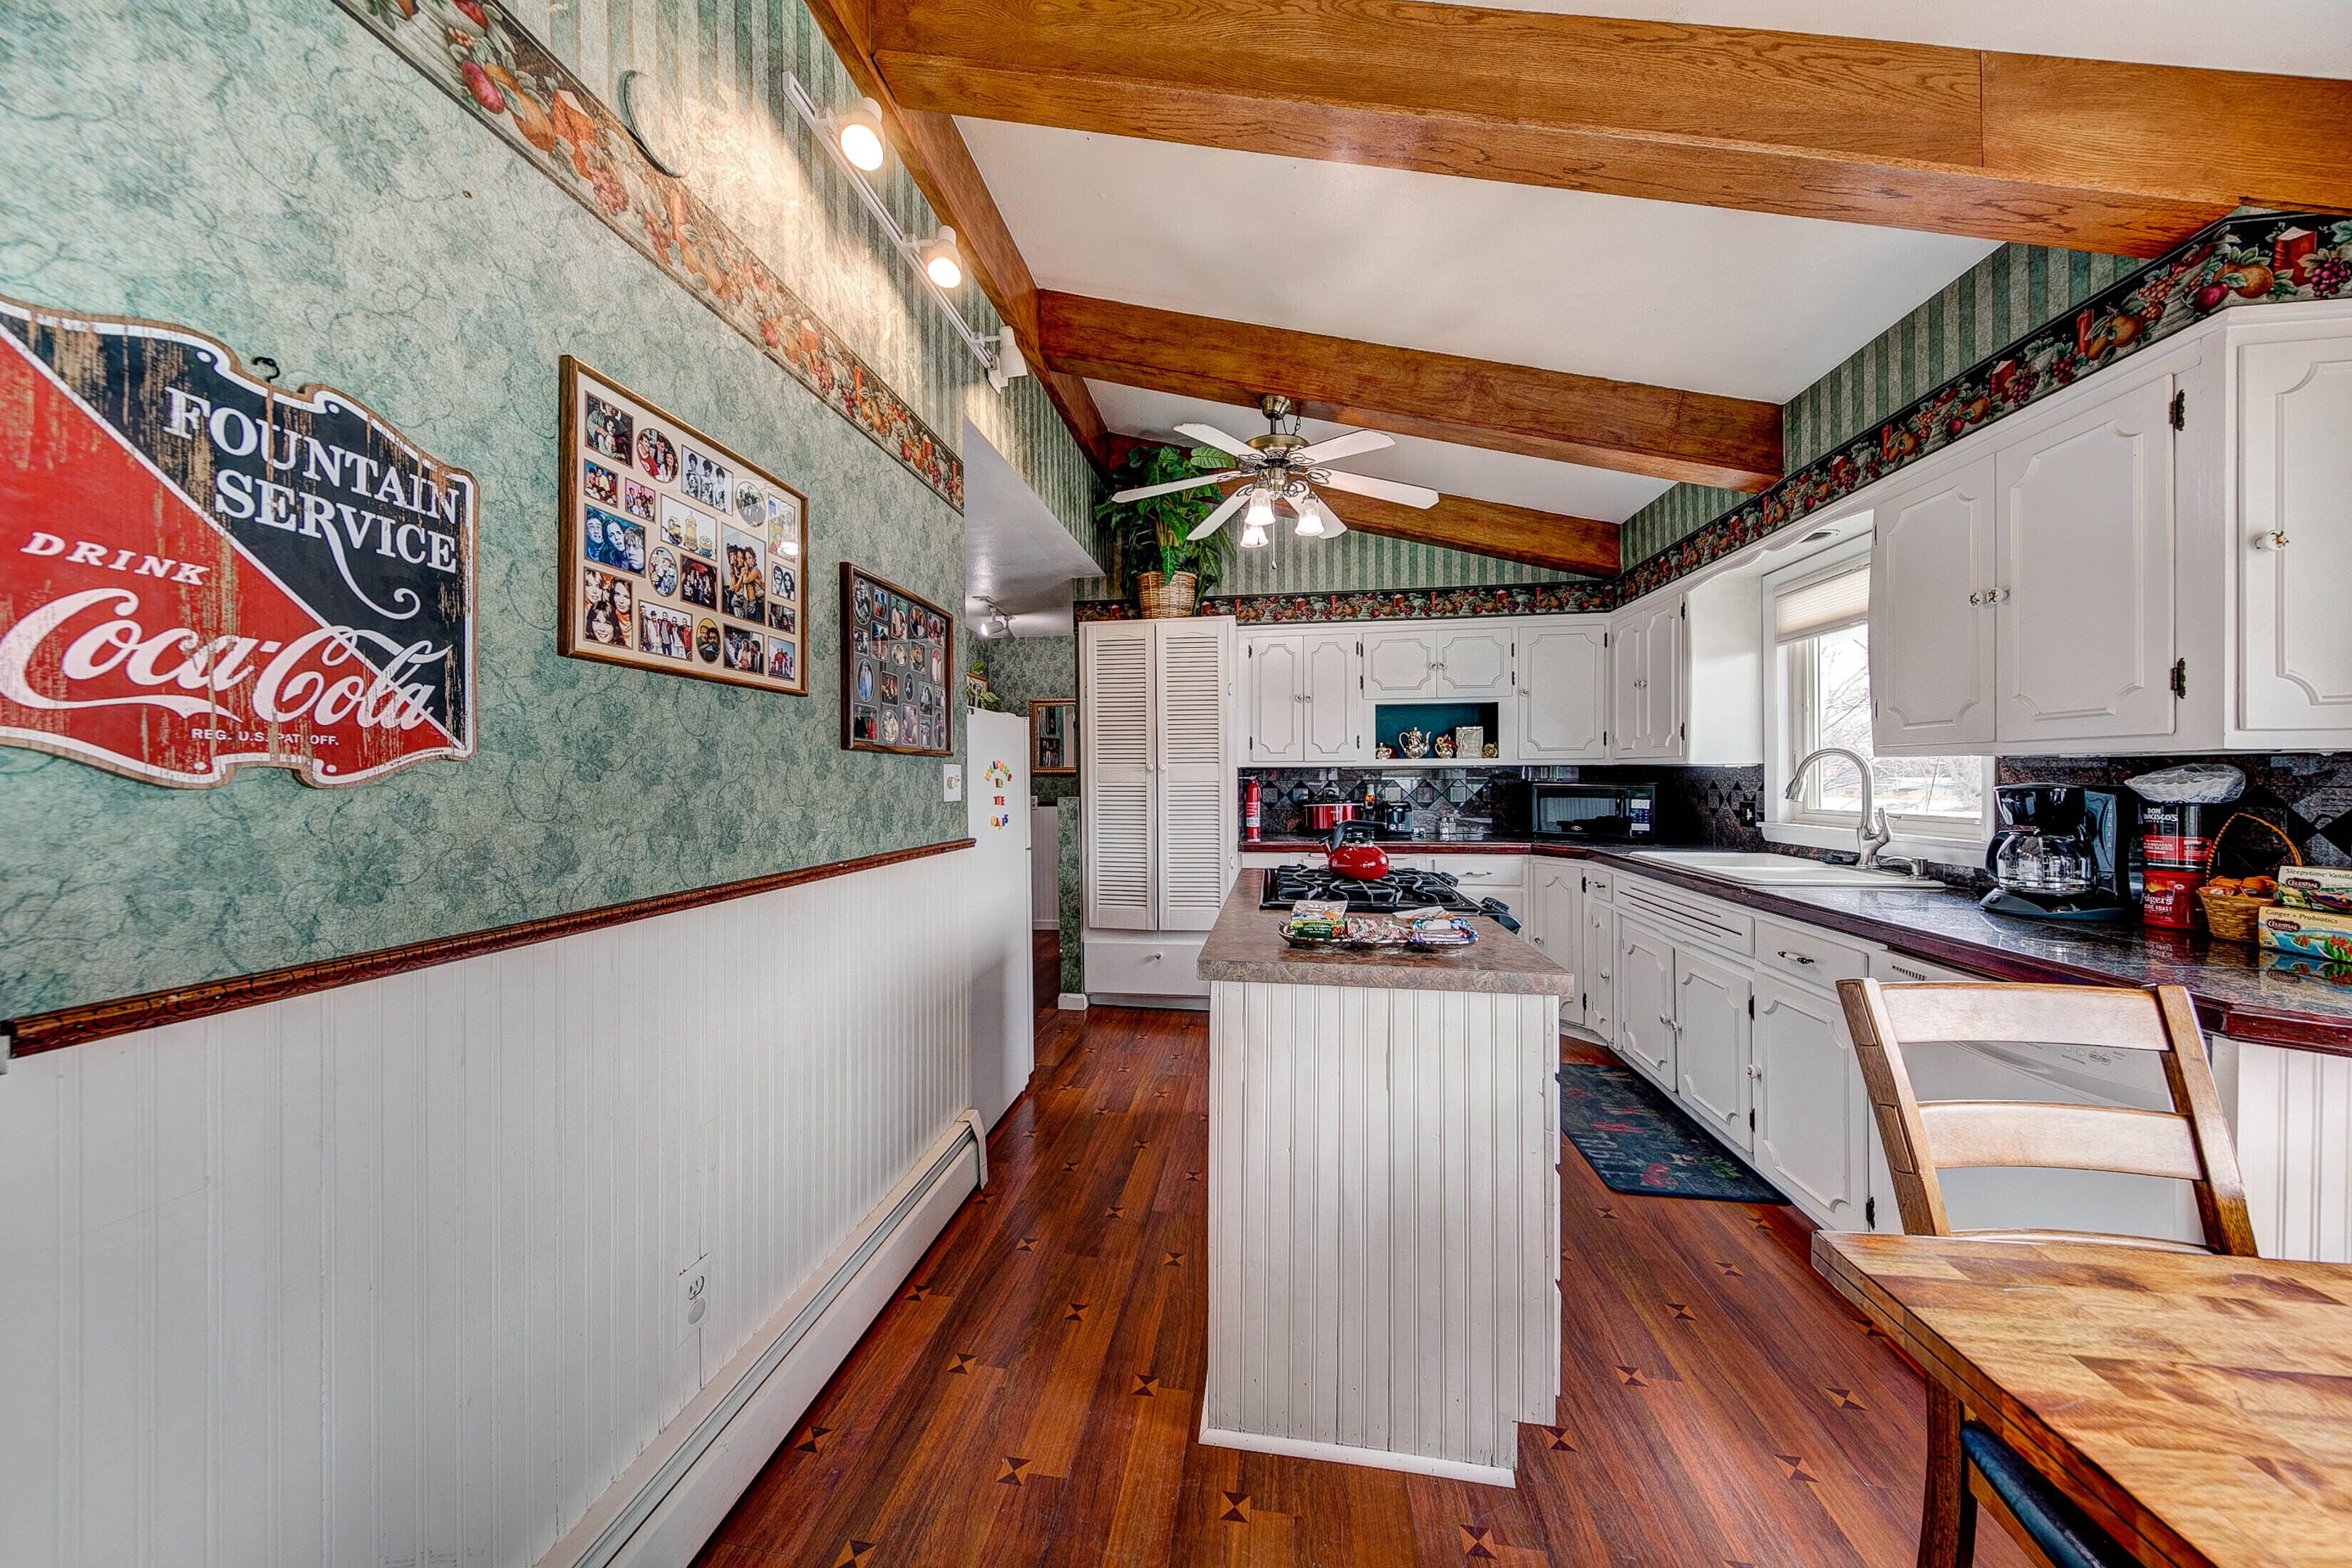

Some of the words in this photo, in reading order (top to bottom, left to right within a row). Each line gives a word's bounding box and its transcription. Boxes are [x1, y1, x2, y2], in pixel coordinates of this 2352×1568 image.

[163, 386, 460, 525] FOUNTAIN
[19, 531, 210, 586] DRINK
[215, 468, 457, 620] SERVICE
[0, 587, 453, 731] Coca-Cola
[190, 728, 232, 741] REG.
[309, 735, 340, 746] OFF.
[2286, 868, 2326, 877] Sleepytime
[2265, 909, 2291, 918] Ginger
[2299, 914, 2338, 924] Probiotics
